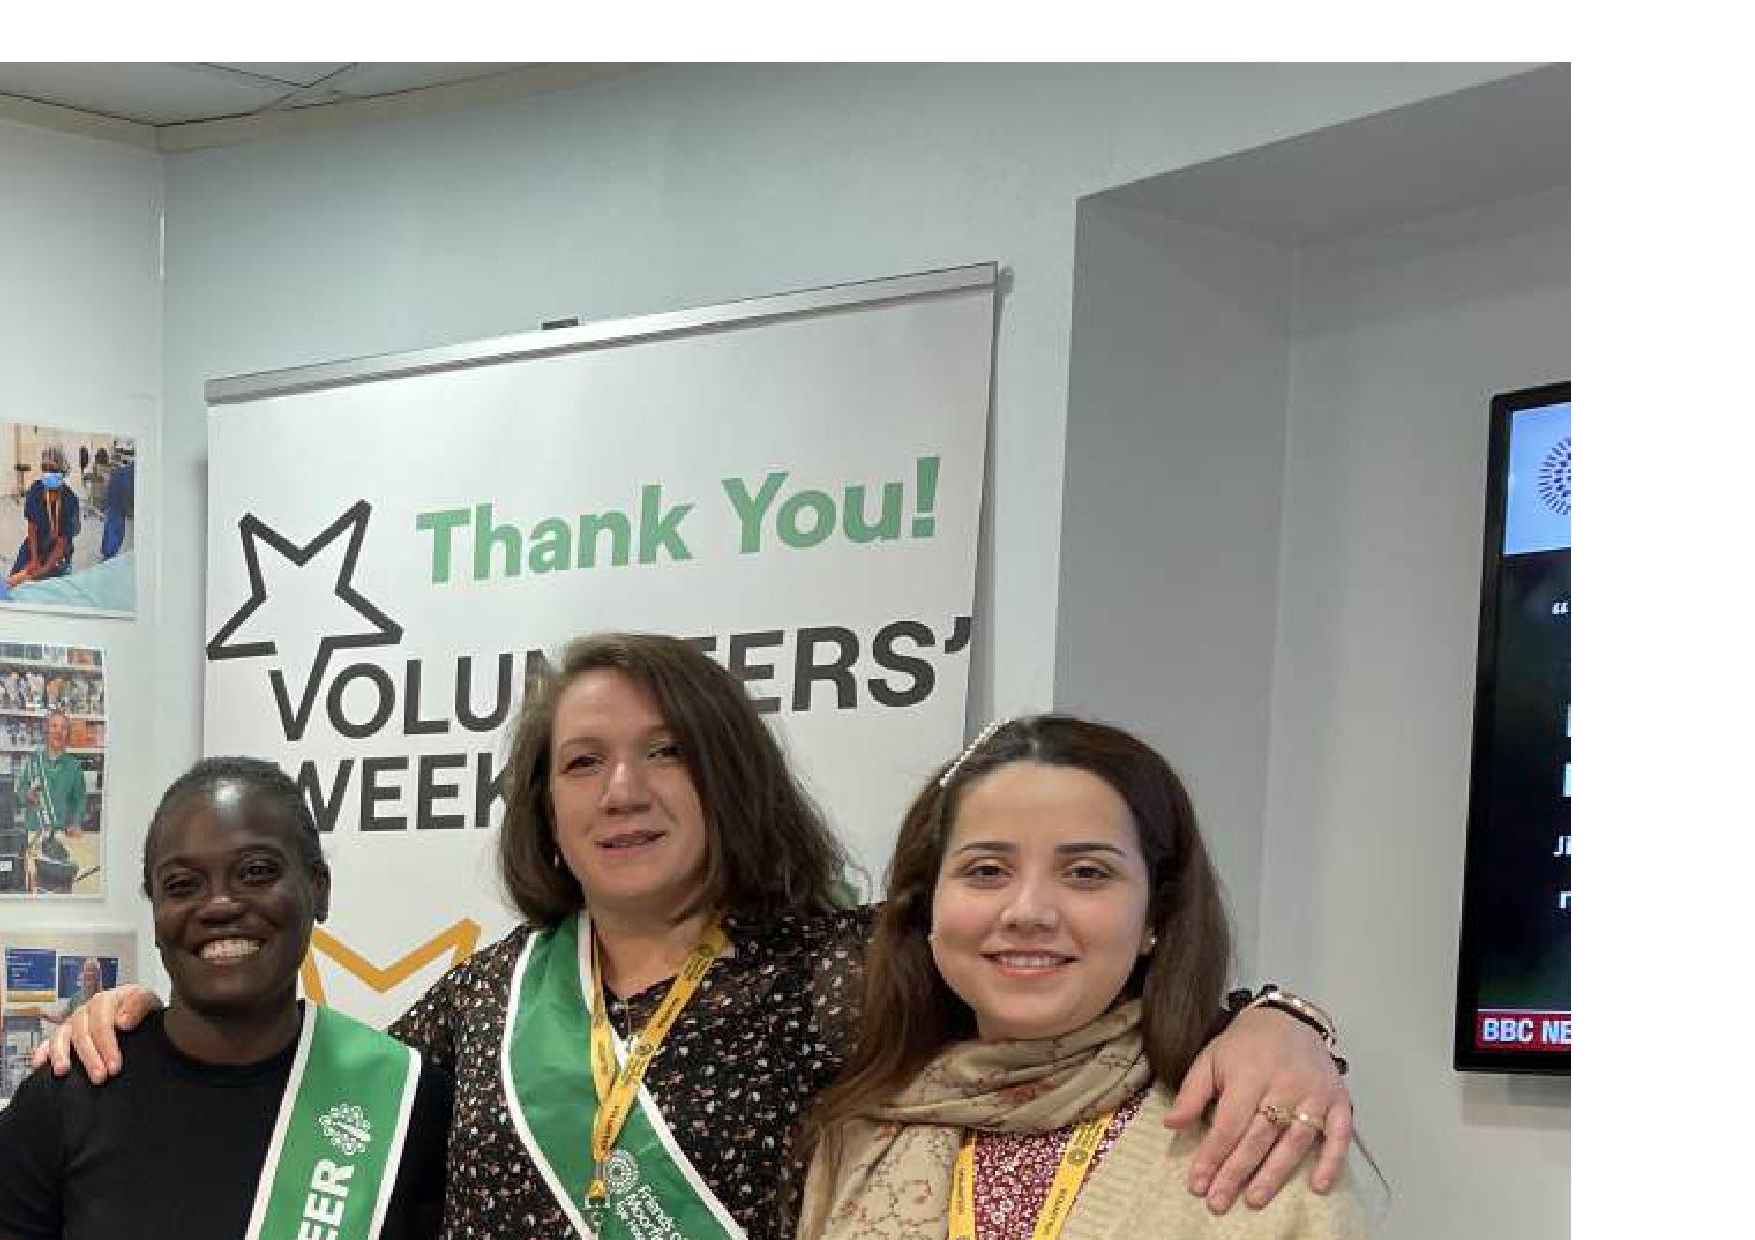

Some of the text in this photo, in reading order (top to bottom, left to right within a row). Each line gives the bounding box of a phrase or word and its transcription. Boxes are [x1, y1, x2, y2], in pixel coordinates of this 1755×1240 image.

[414, 455, 942, 586] Thank You!
[267, 616, 972, 742] VOLUERS'
[1482, 1017, 1571, 1045] BBC NE
